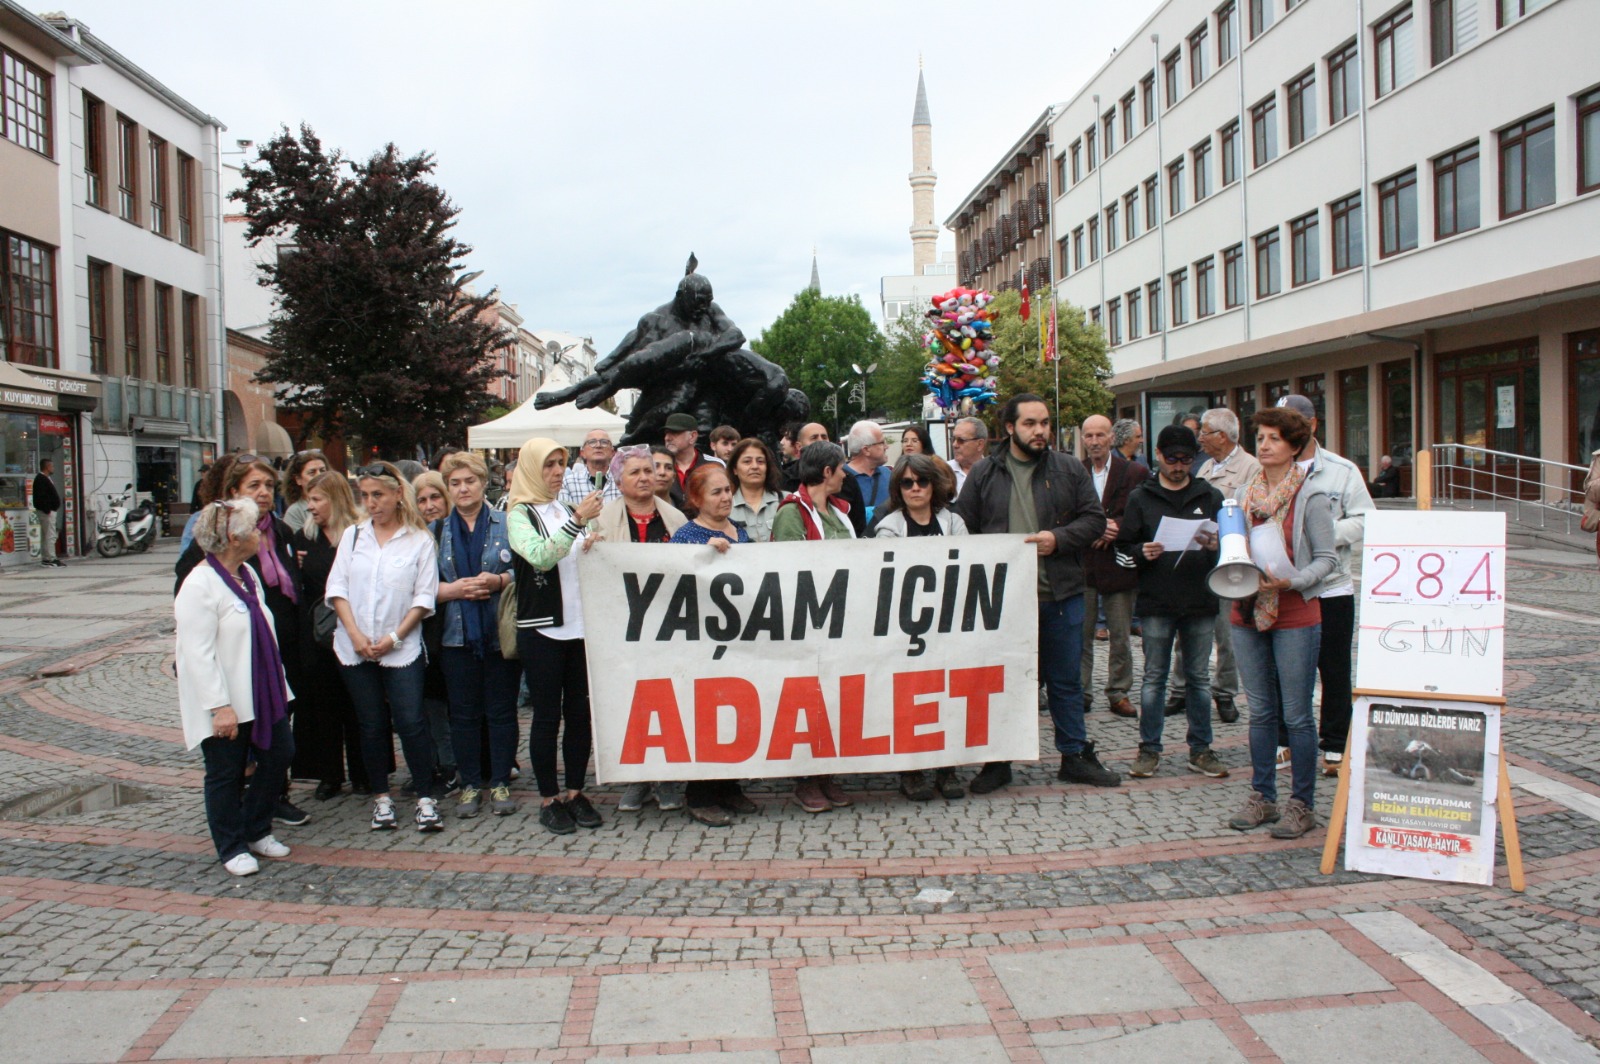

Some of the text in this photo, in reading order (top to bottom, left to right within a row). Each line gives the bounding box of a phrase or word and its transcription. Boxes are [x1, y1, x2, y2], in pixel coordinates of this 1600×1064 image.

[4, 391, 53, 407] KUYUMCULUK
[623, 548, 1008, 661] YAŞAM İÇİN
[1379, 617, 1490, 658] GÜN
[620, 665, 1005, 765] ADALET
[1373, 709, 1481, 732] BU DÜNYADA BİZLERDE VARIZ
[1373, 792, 1472, 809] ONLARI KURTARMAK
[1372, 801, 1472, 821] BİZİM ELİMİZDE!
[1428, 821, 1448, 829] HAYIR
[1376, 831, 1400, 845] KANLI
